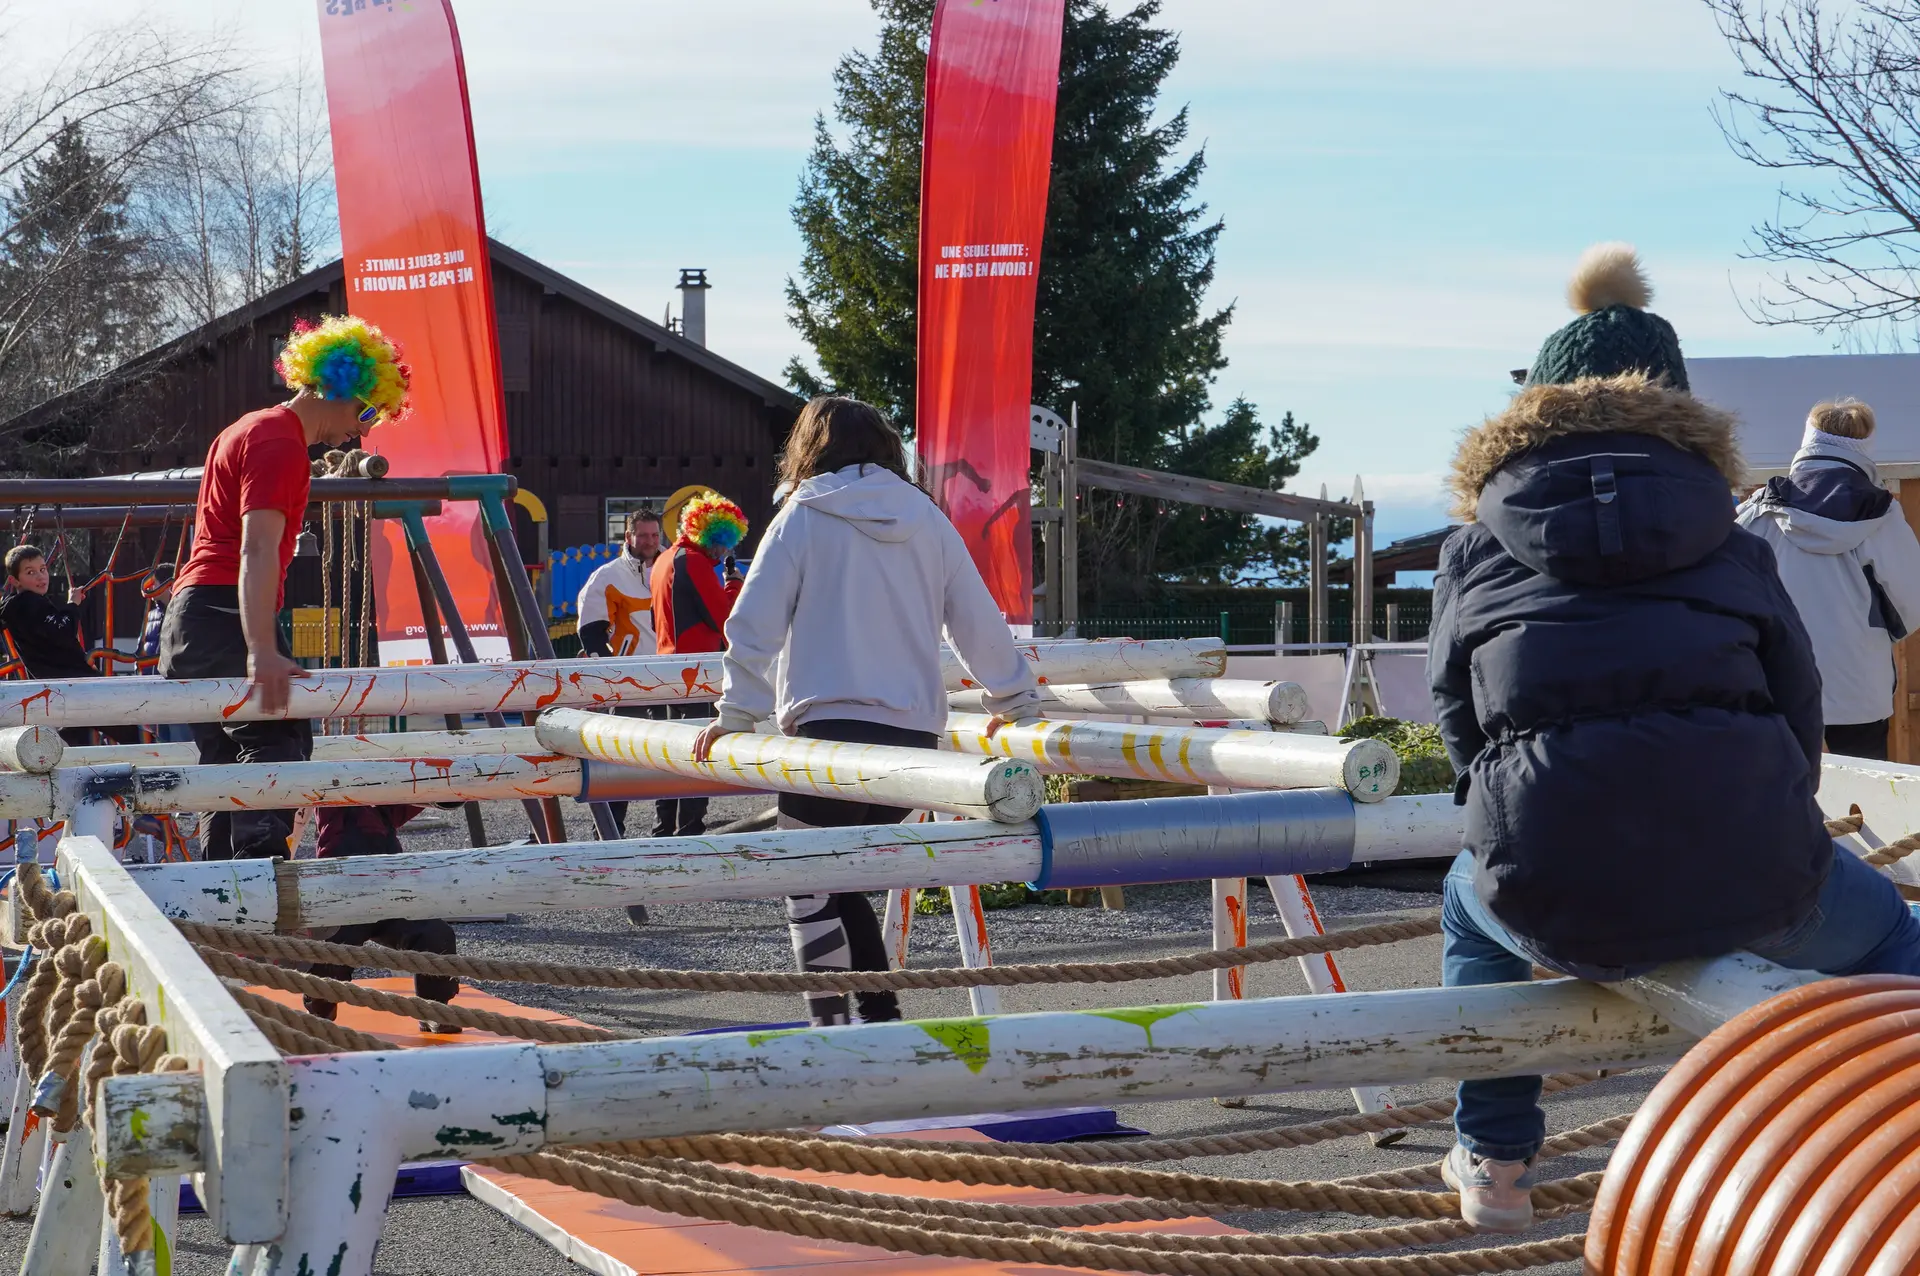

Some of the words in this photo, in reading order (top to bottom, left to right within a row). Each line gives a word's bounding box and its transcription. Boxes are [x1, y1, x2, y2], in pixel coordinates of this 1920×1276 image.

[941, 245, 961, 259] UNE
[963, 244, 990, 258] SEULE
[991, 243, 1024, 257] LIMITE
[935, 263, 949, 279] NE
[952, 263, 974, 279] PAS
[976, 262, 989, 277] EN
[990, 261, 1027, 277] AVOIR
